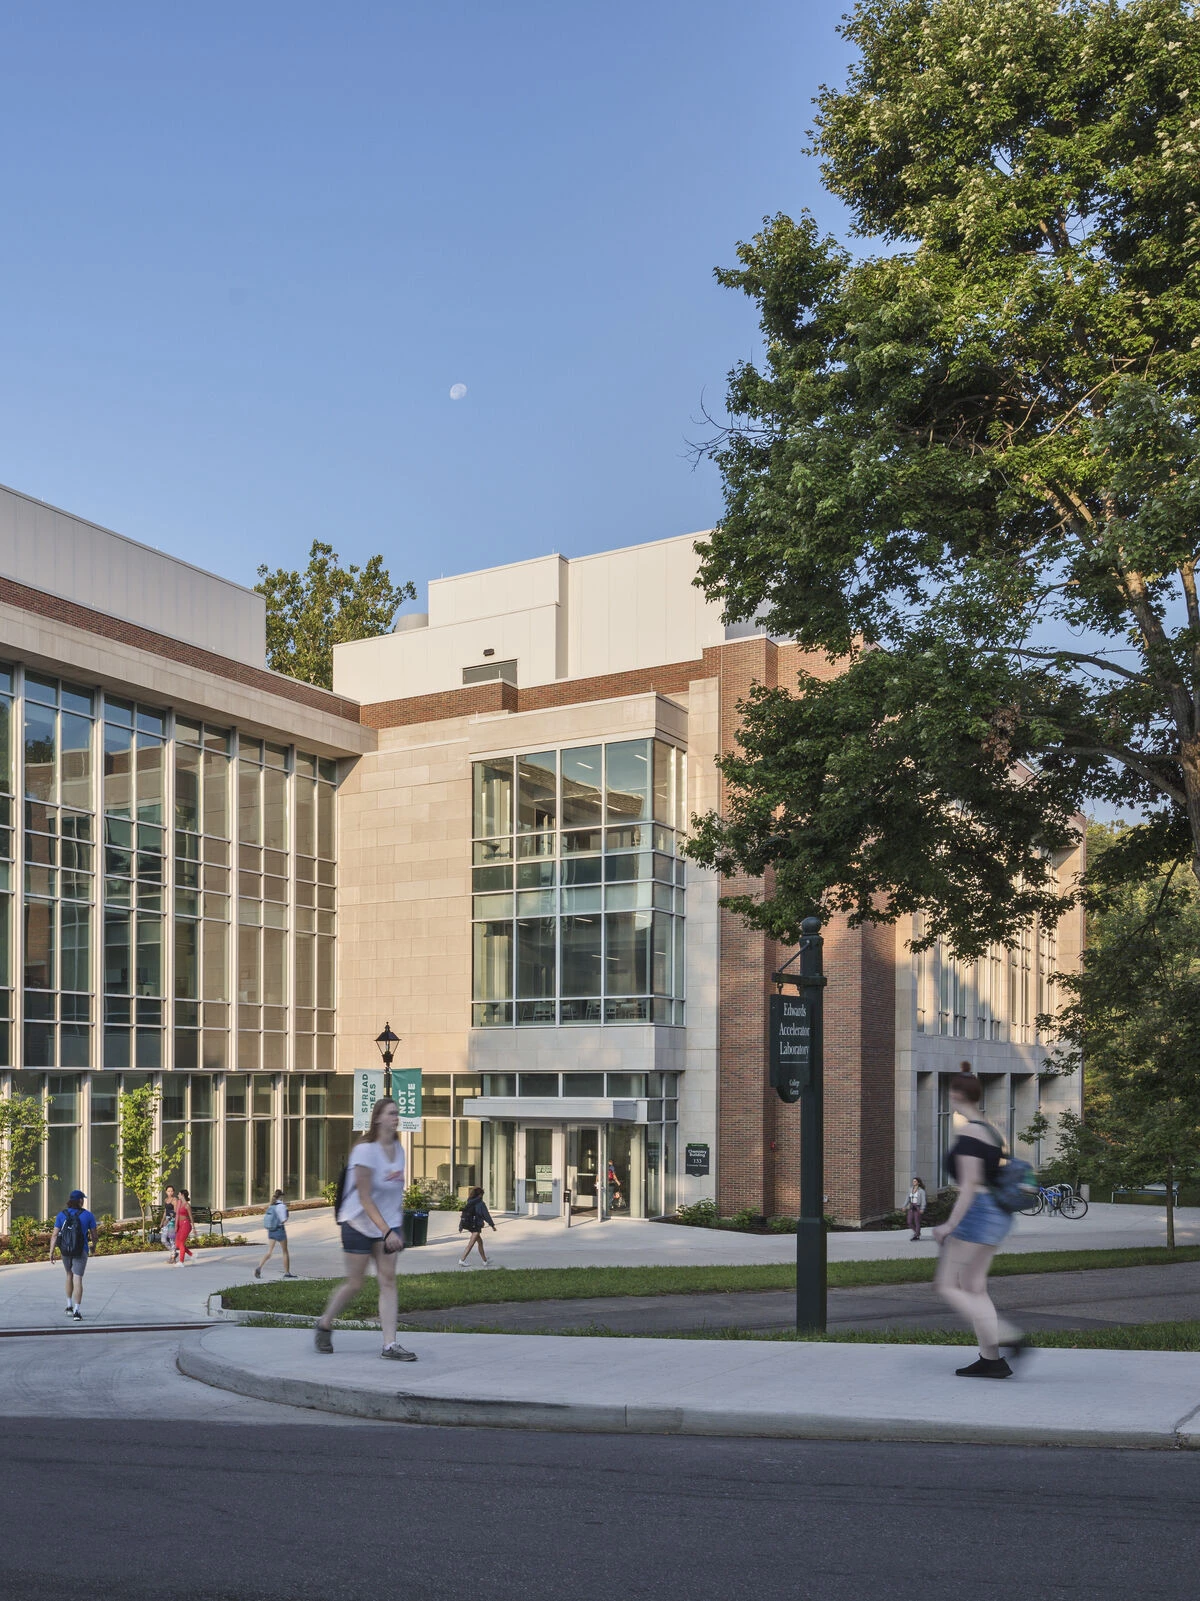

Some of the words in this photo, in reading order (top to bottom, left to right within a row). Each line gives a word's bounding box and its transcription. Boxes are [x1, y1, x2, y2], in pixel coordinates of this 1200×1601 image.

[783, 1002, 807, 1017] Edwards
[779, 1022, 810, 1037] Accelerator
[779, 1041, 809, 1060] Laboratory
[408, 1083, 416, 1114] HATE
